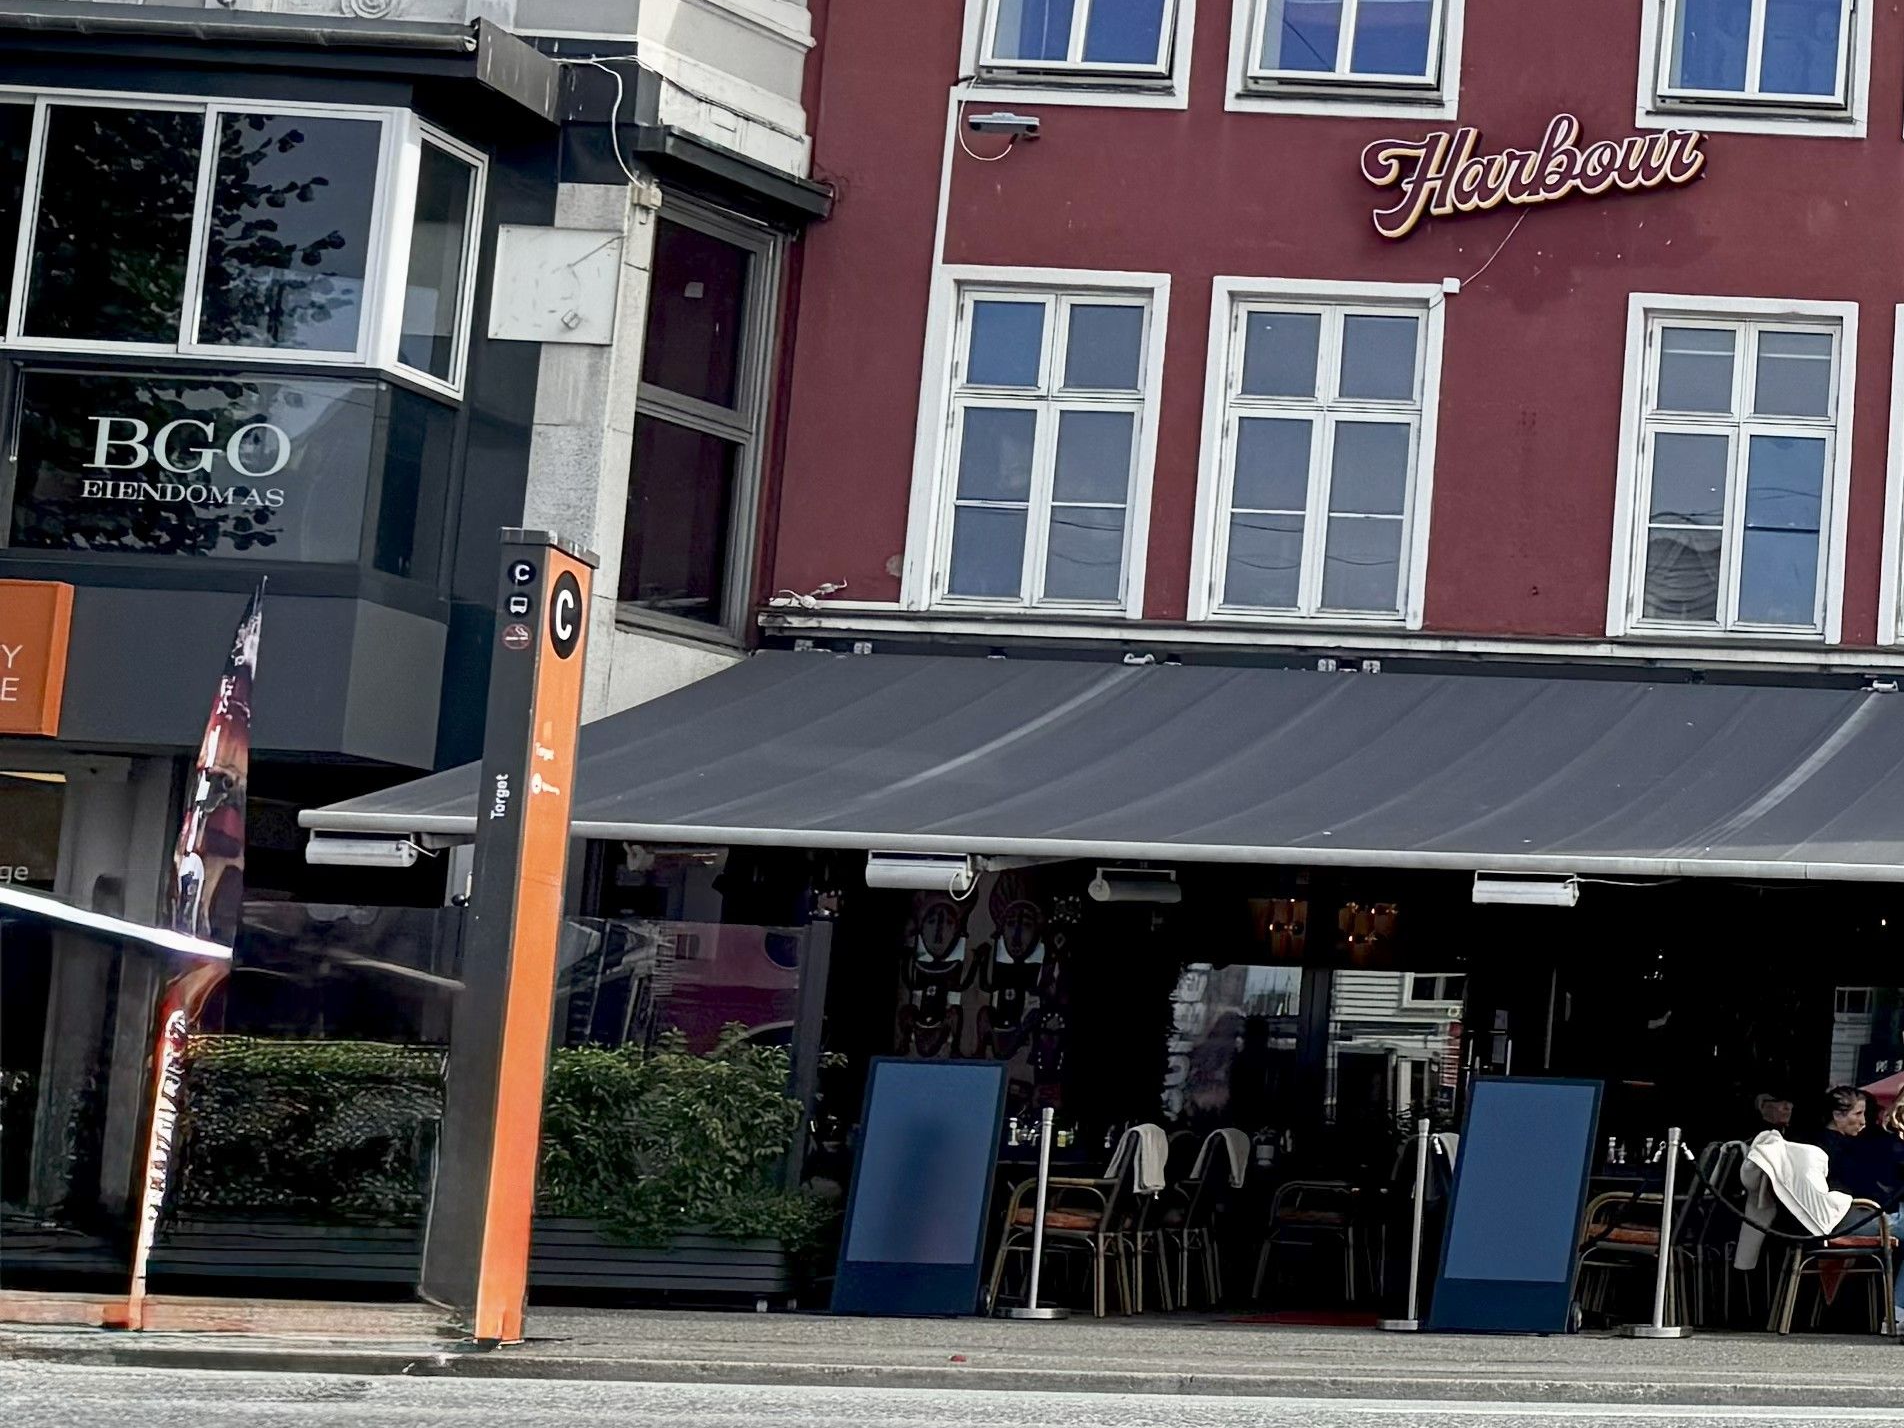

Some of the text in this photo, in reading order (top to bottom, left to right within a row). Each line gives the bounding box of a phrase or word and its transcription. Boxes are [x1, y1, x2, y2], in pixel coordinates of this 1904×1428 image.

[1361, 113, 1707, 238] Harbour
[82, 416, 291, 477] BGO
[80, 479, 285, 507] EIENDOM AS
[555, 589, 575, 641] C
